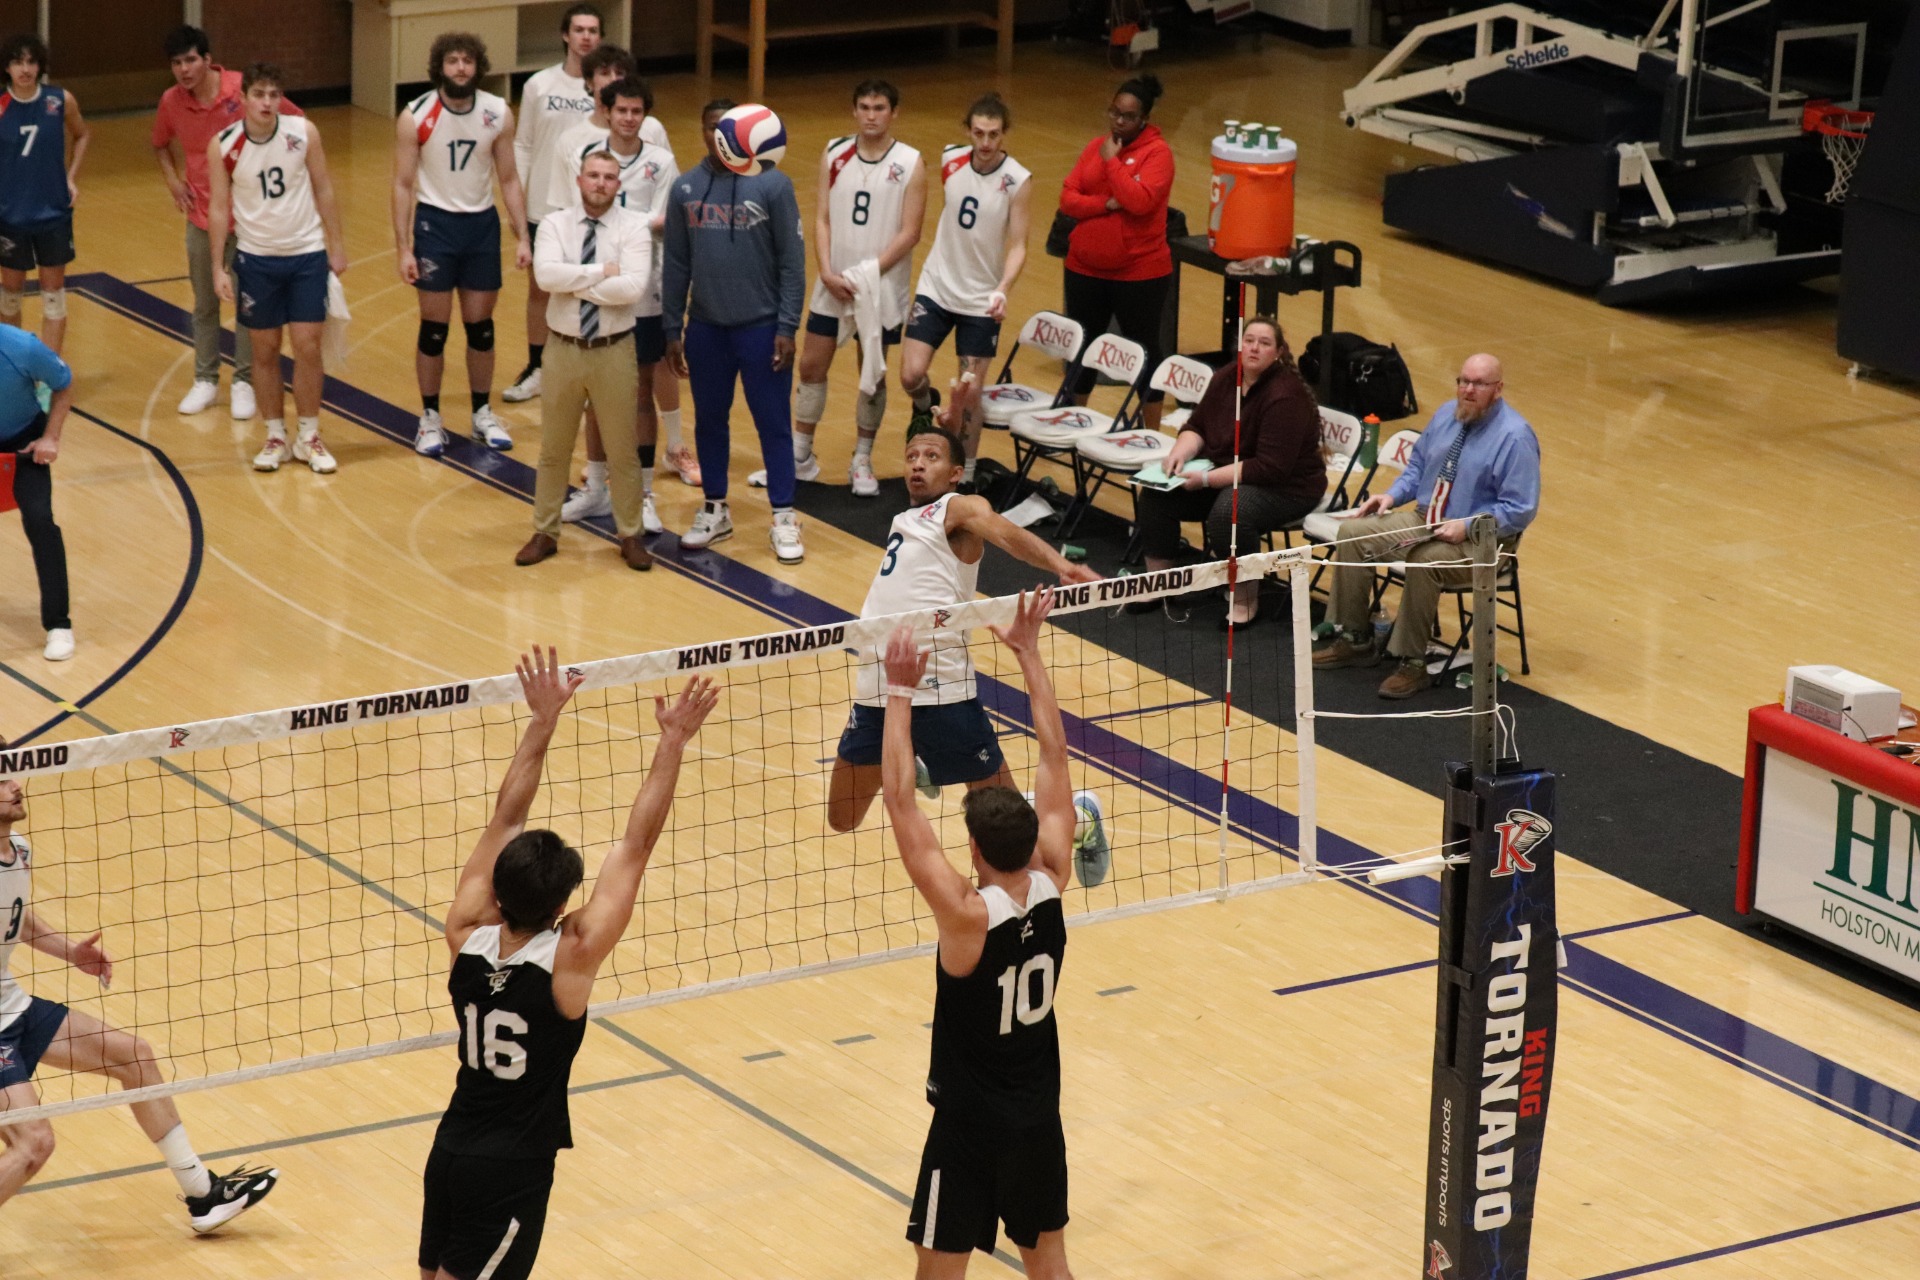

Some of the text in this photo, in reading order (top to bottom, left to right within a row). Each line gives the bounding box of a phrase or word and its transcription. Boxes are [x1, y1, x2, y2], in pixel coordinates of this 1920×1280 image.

[1505, 43, 1569, 69] Schelde
[547, 96, 583, 112] KING
[19, 124, 39, 157] 7
[446, 140, 477, 172] 17
[257, 166, 286, 200] 13
[683, 200, 747, 228] KING
[852, 190, 871, 226] 8
[958, 196, 979, 230] 6
[1030, 318, 1074, 348] KING
[1094, 341, 1137, 372] KING
[1163, 362, 1206, 393] KING
[880, 532, 904, 577] 3
[1041, 585, 1090, 610] ING
[1098, 568, 1193, 601] TORNADO
[677, 626, 845, 670] KING TORNADO
[290, 684, 470, 730] KING TORNADO
[0, 745, 69, 774] NADO
[4, 896, 23, 942] 9
[1821, 899, 1901, 953] HOLSTON
[997, 953, 1055, 1036] 10
[463, 1002, 529, 1081] 16
[1473, 924, 1531, 1233] TORNADO
[1519, 1028, 1548, 1118] KING
[1438, 1098, 1452, 1228] sports imports
